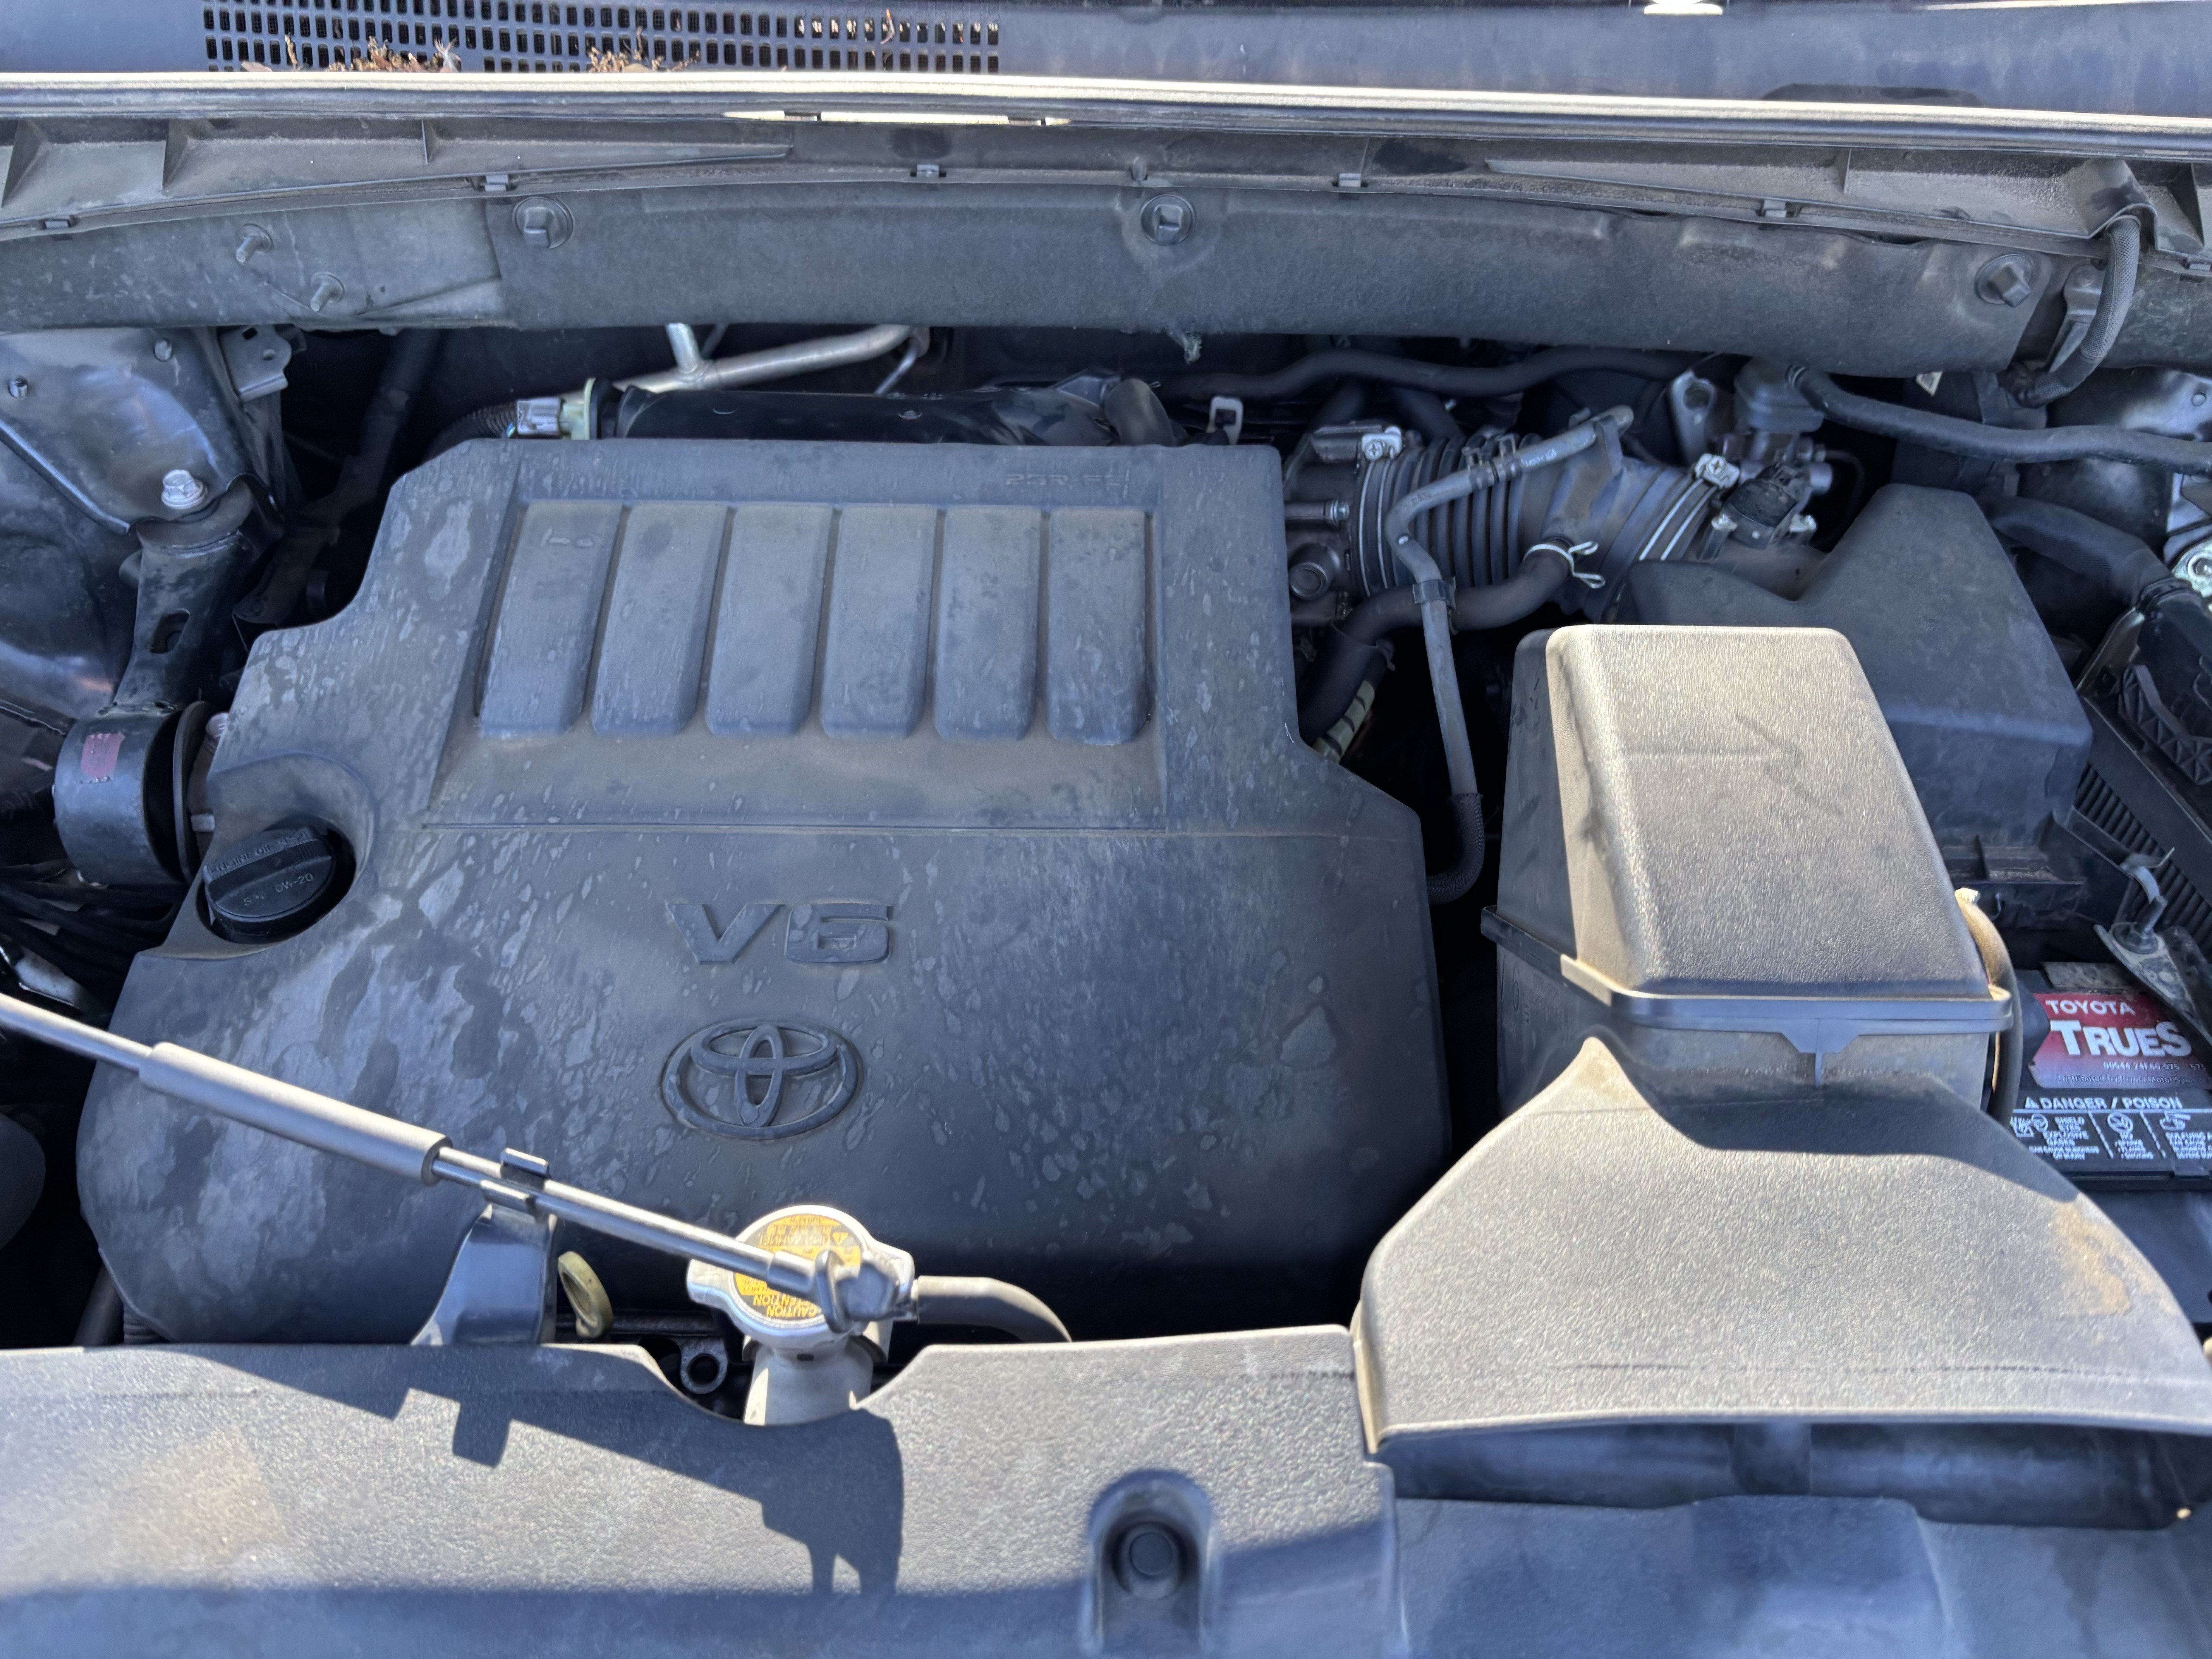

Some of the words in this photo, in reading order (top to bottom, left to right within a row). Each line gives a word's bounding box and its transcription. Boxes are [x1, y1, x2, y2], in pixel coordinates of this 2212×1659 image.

[665, 902, 892, 964] V6
[2045, 1000, 2136, 1016] TOYOTA
[2050, 1020, 2192, 1057] TRUES
[2039, 1097, 2108, 1110] DANGER
[2111, 1097, 2118, 1109] /
[2121, 1097, 2183, 1110] POISON
[766, 1304, 818, 1318] CAUTION
